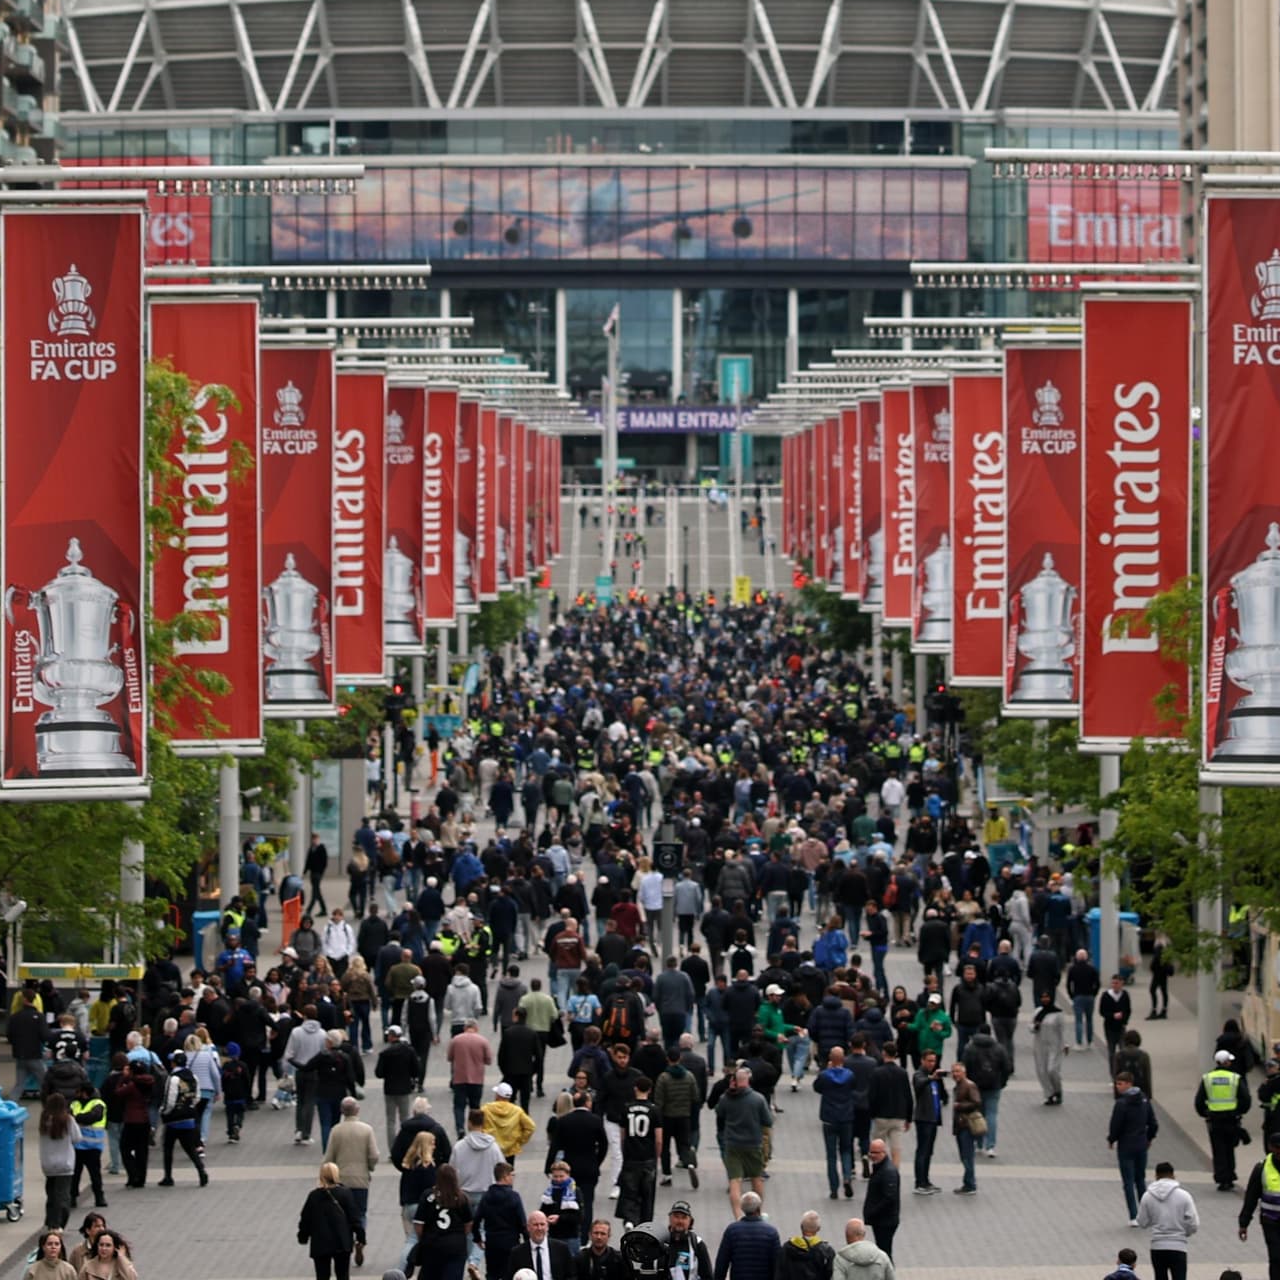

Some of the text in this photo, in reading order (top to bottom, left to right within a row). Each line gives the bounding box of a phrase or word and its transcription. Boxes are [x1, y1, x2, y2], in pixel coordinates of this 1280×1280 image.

[1046, 203, 1181, 247] Emira
[30, 339, 116, 358] Emirates
[1233, 344, 1263, 365] FA
[31, 360, 117, 380] FA CUP
[630, 412, 674, 428] MAIN
[677, 412, 755, 428] ENTRANC
[263, 428, 318, 440] Emirates
[1022, 427, 1076, 440] Emirates
[263, 441, 318, 455] FA CUP
[1022, 441, 1076, 455] FA CUP
[334, 429, 365, 616] Emirates
[963, 431, 1004, 620] Emirates
[1099, 381, 1160, 655] Emirates
[12, 629, 35, 713] Emirates
[124, 648, 142, 713] Emirates
[1207, 636, 1225, 704] Emirates
[627, 1113, 650, 1137] 10
